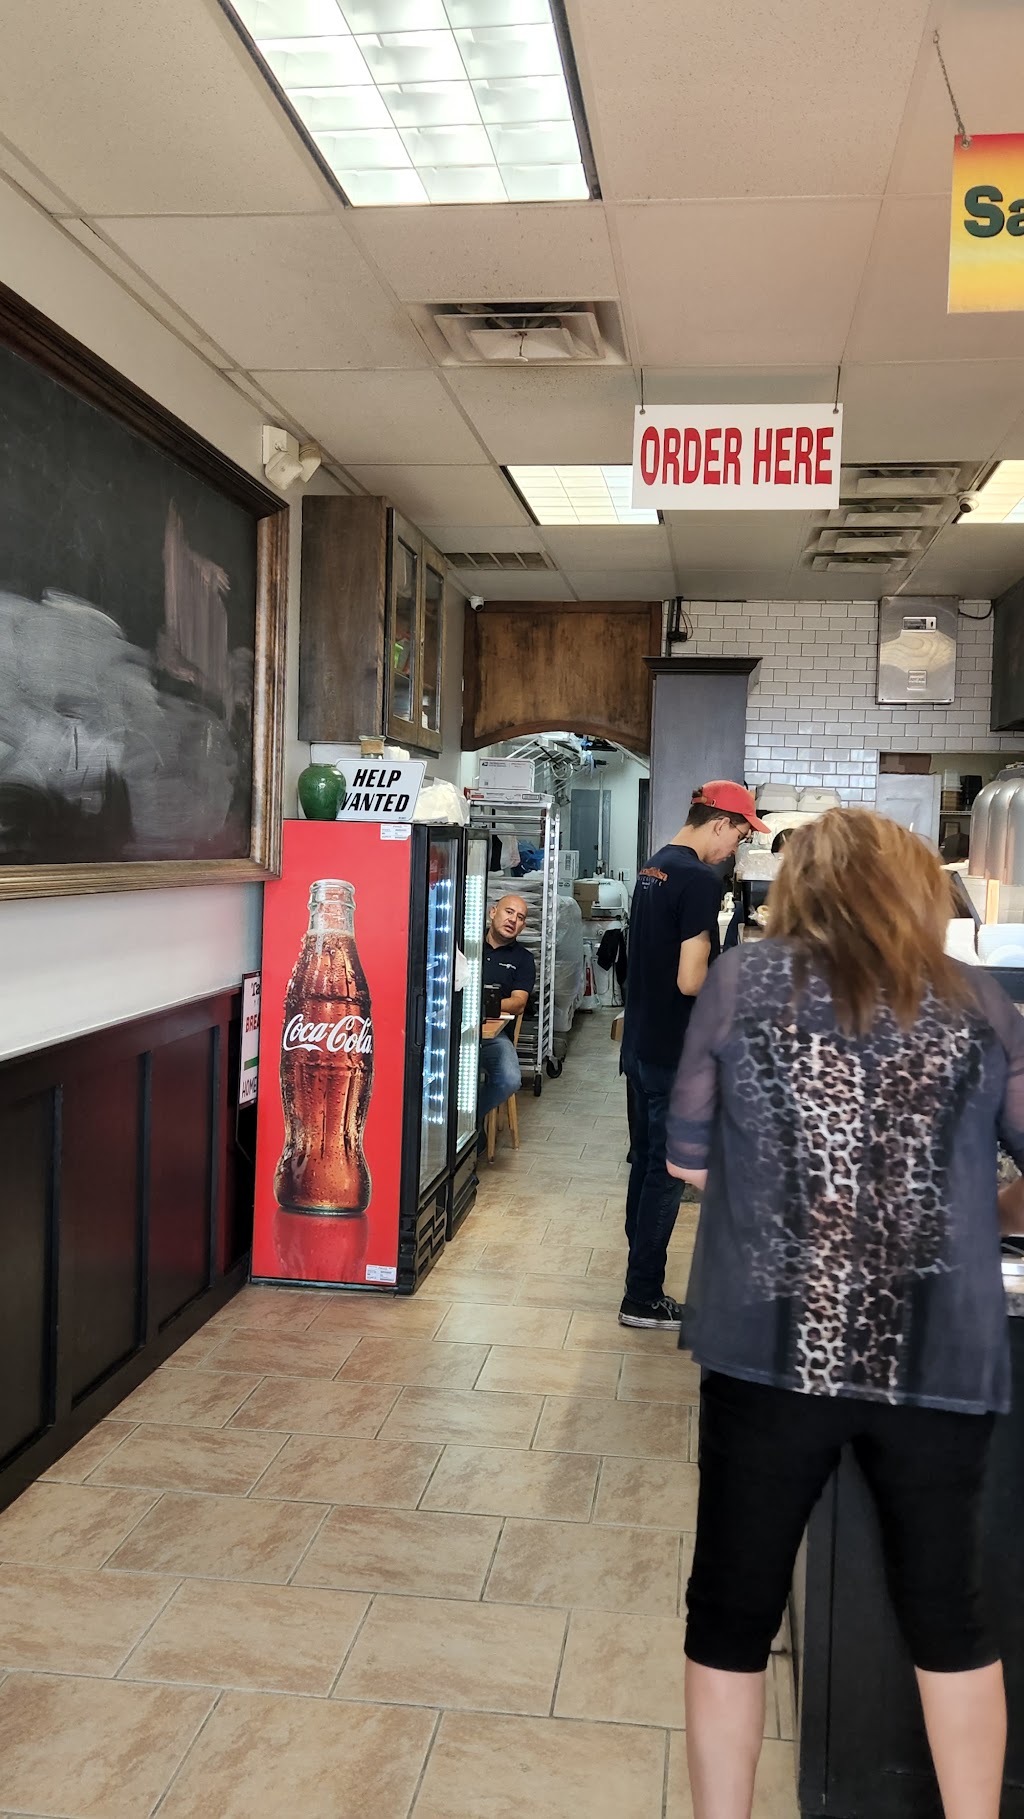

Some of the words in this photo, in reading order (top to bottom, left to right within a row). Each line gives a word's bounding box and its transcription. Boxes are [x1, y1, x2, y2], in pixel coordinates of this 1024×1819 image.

[640, 425, 742, 486] ORDER
[752, 426, 834, 486] HERE
[352, 768, 402, 788] HELP
[283, 1013, 373, 1054] Coca-Cola
